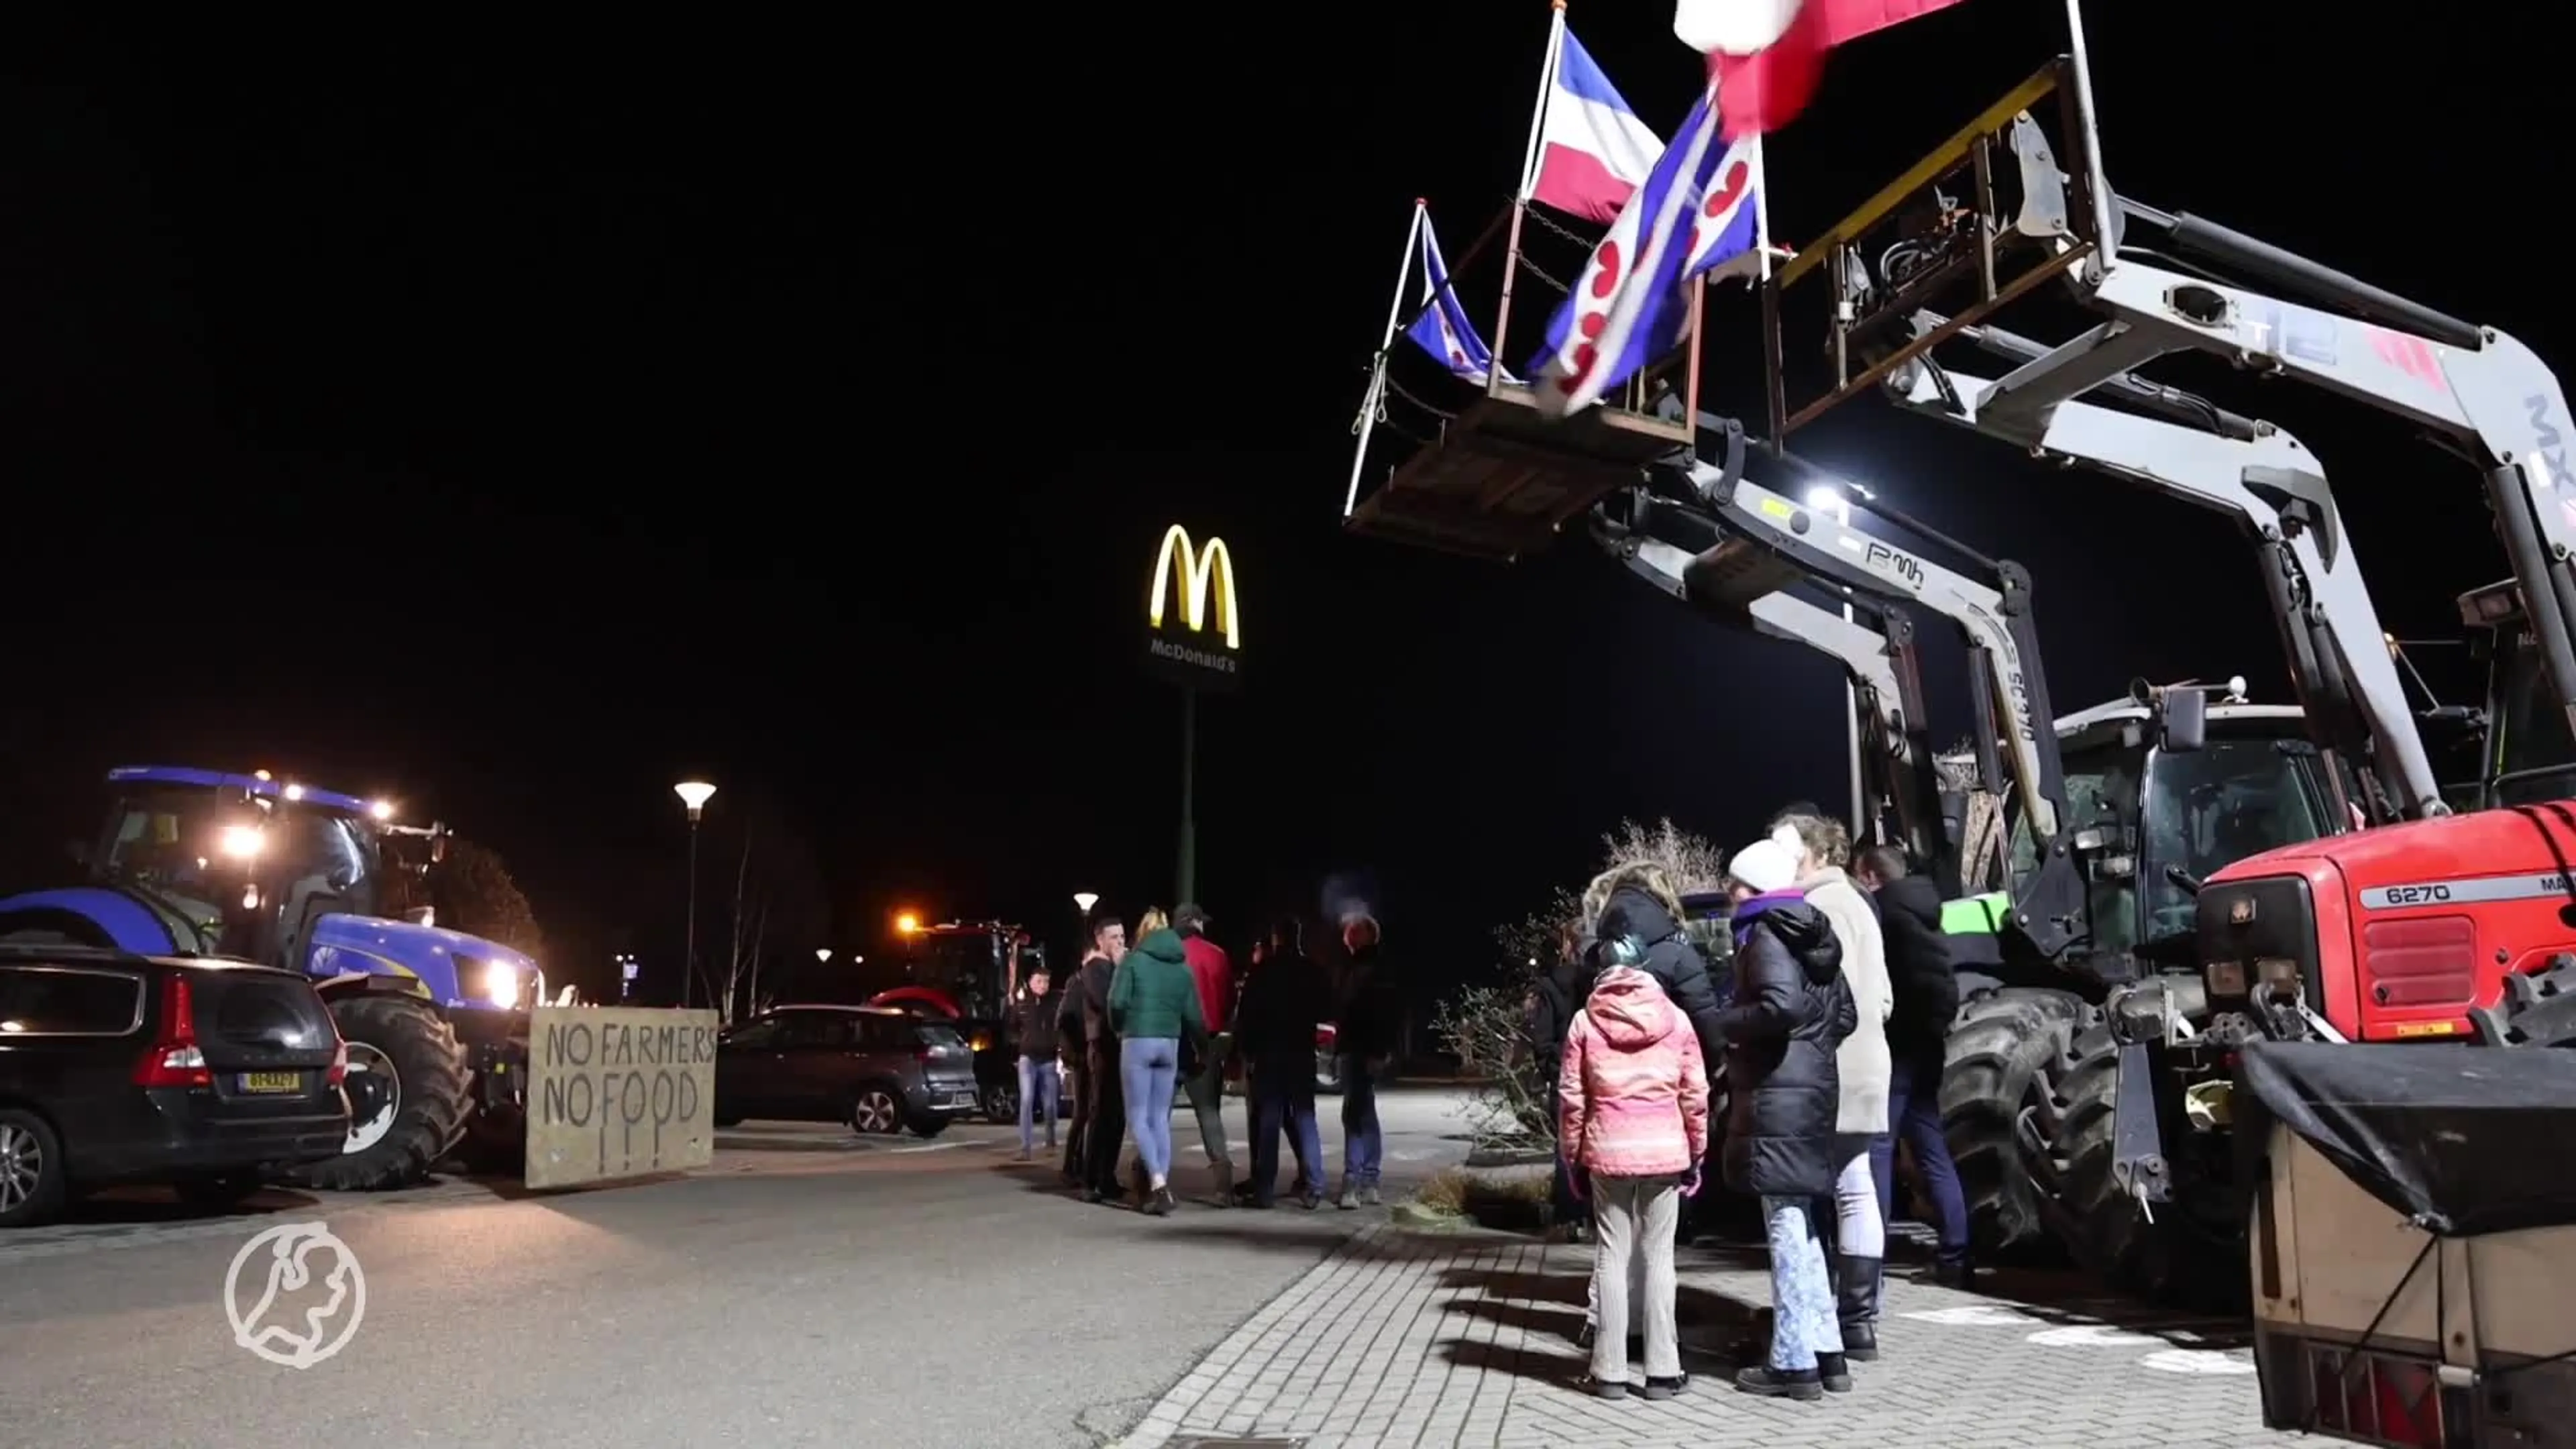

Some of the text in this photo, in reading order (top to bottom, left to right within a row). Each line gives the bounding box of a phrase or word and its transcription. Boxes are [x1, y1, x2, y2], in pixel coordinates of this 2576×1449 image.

[1150, 638, 1236, 674] McDonald's
[2386, 876, 2576, 904] 6270 MA
[545, 1022, 718, 1068] NO FARMERS
[543, 1069, 699, 1128] NO FOOD
